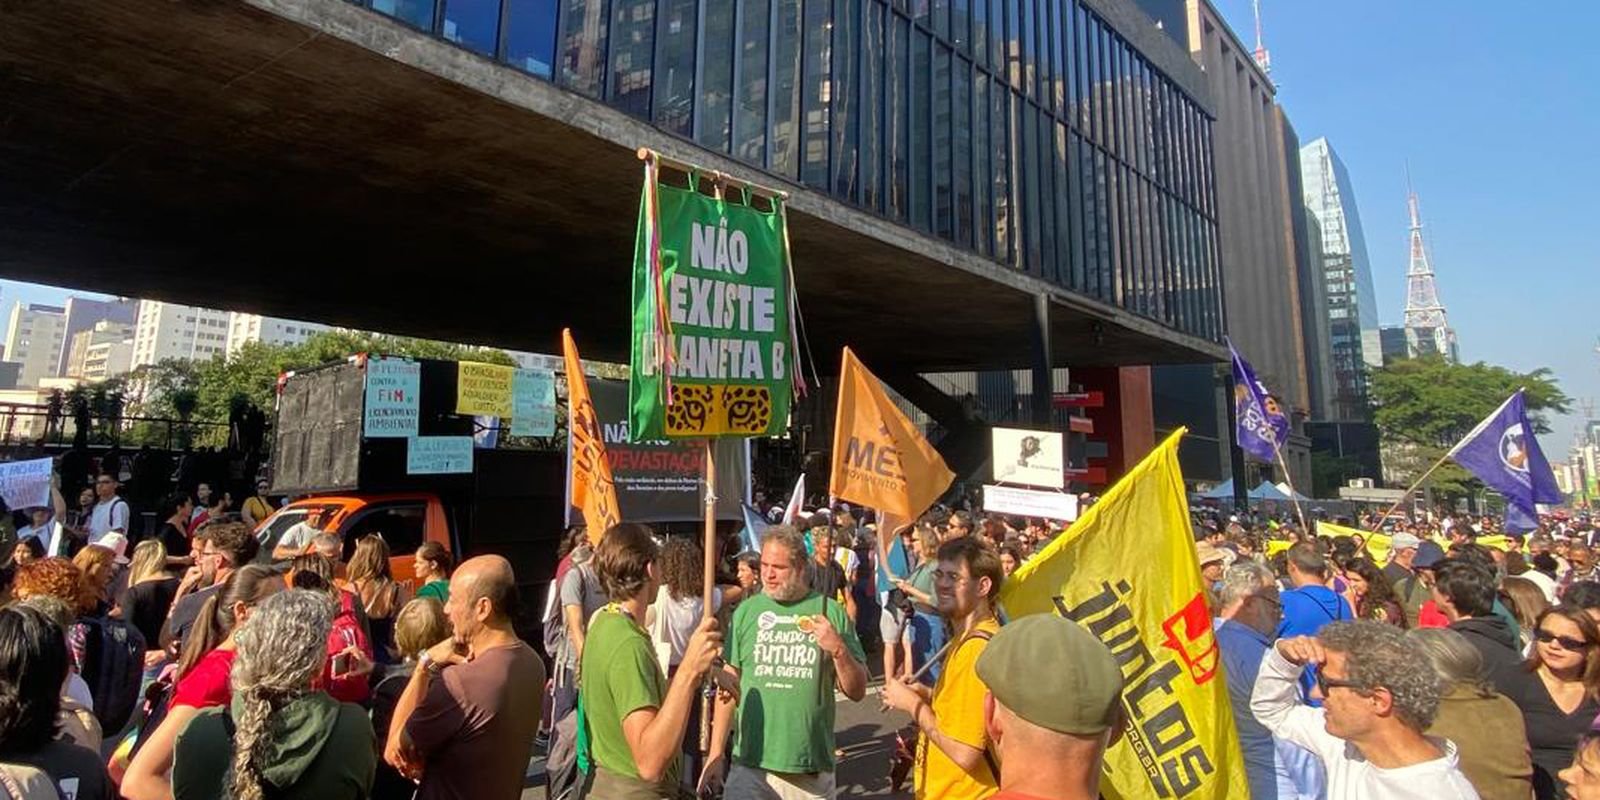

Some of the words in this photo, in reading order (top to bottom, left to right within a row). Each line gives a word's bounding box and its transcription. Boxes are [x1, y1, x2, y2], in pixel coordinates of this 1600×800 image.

[691, 216, 749, 275] NÃO
[670, 272, 775, 332] EXISTE
[772, 341, 785, 380] B
[378, 389, 404, 402] FIM
[604, 420, 630, 444] NÃ
[753, 644, 817, 666] FUTURO
[1052, 578, 1215, 800] juntos
